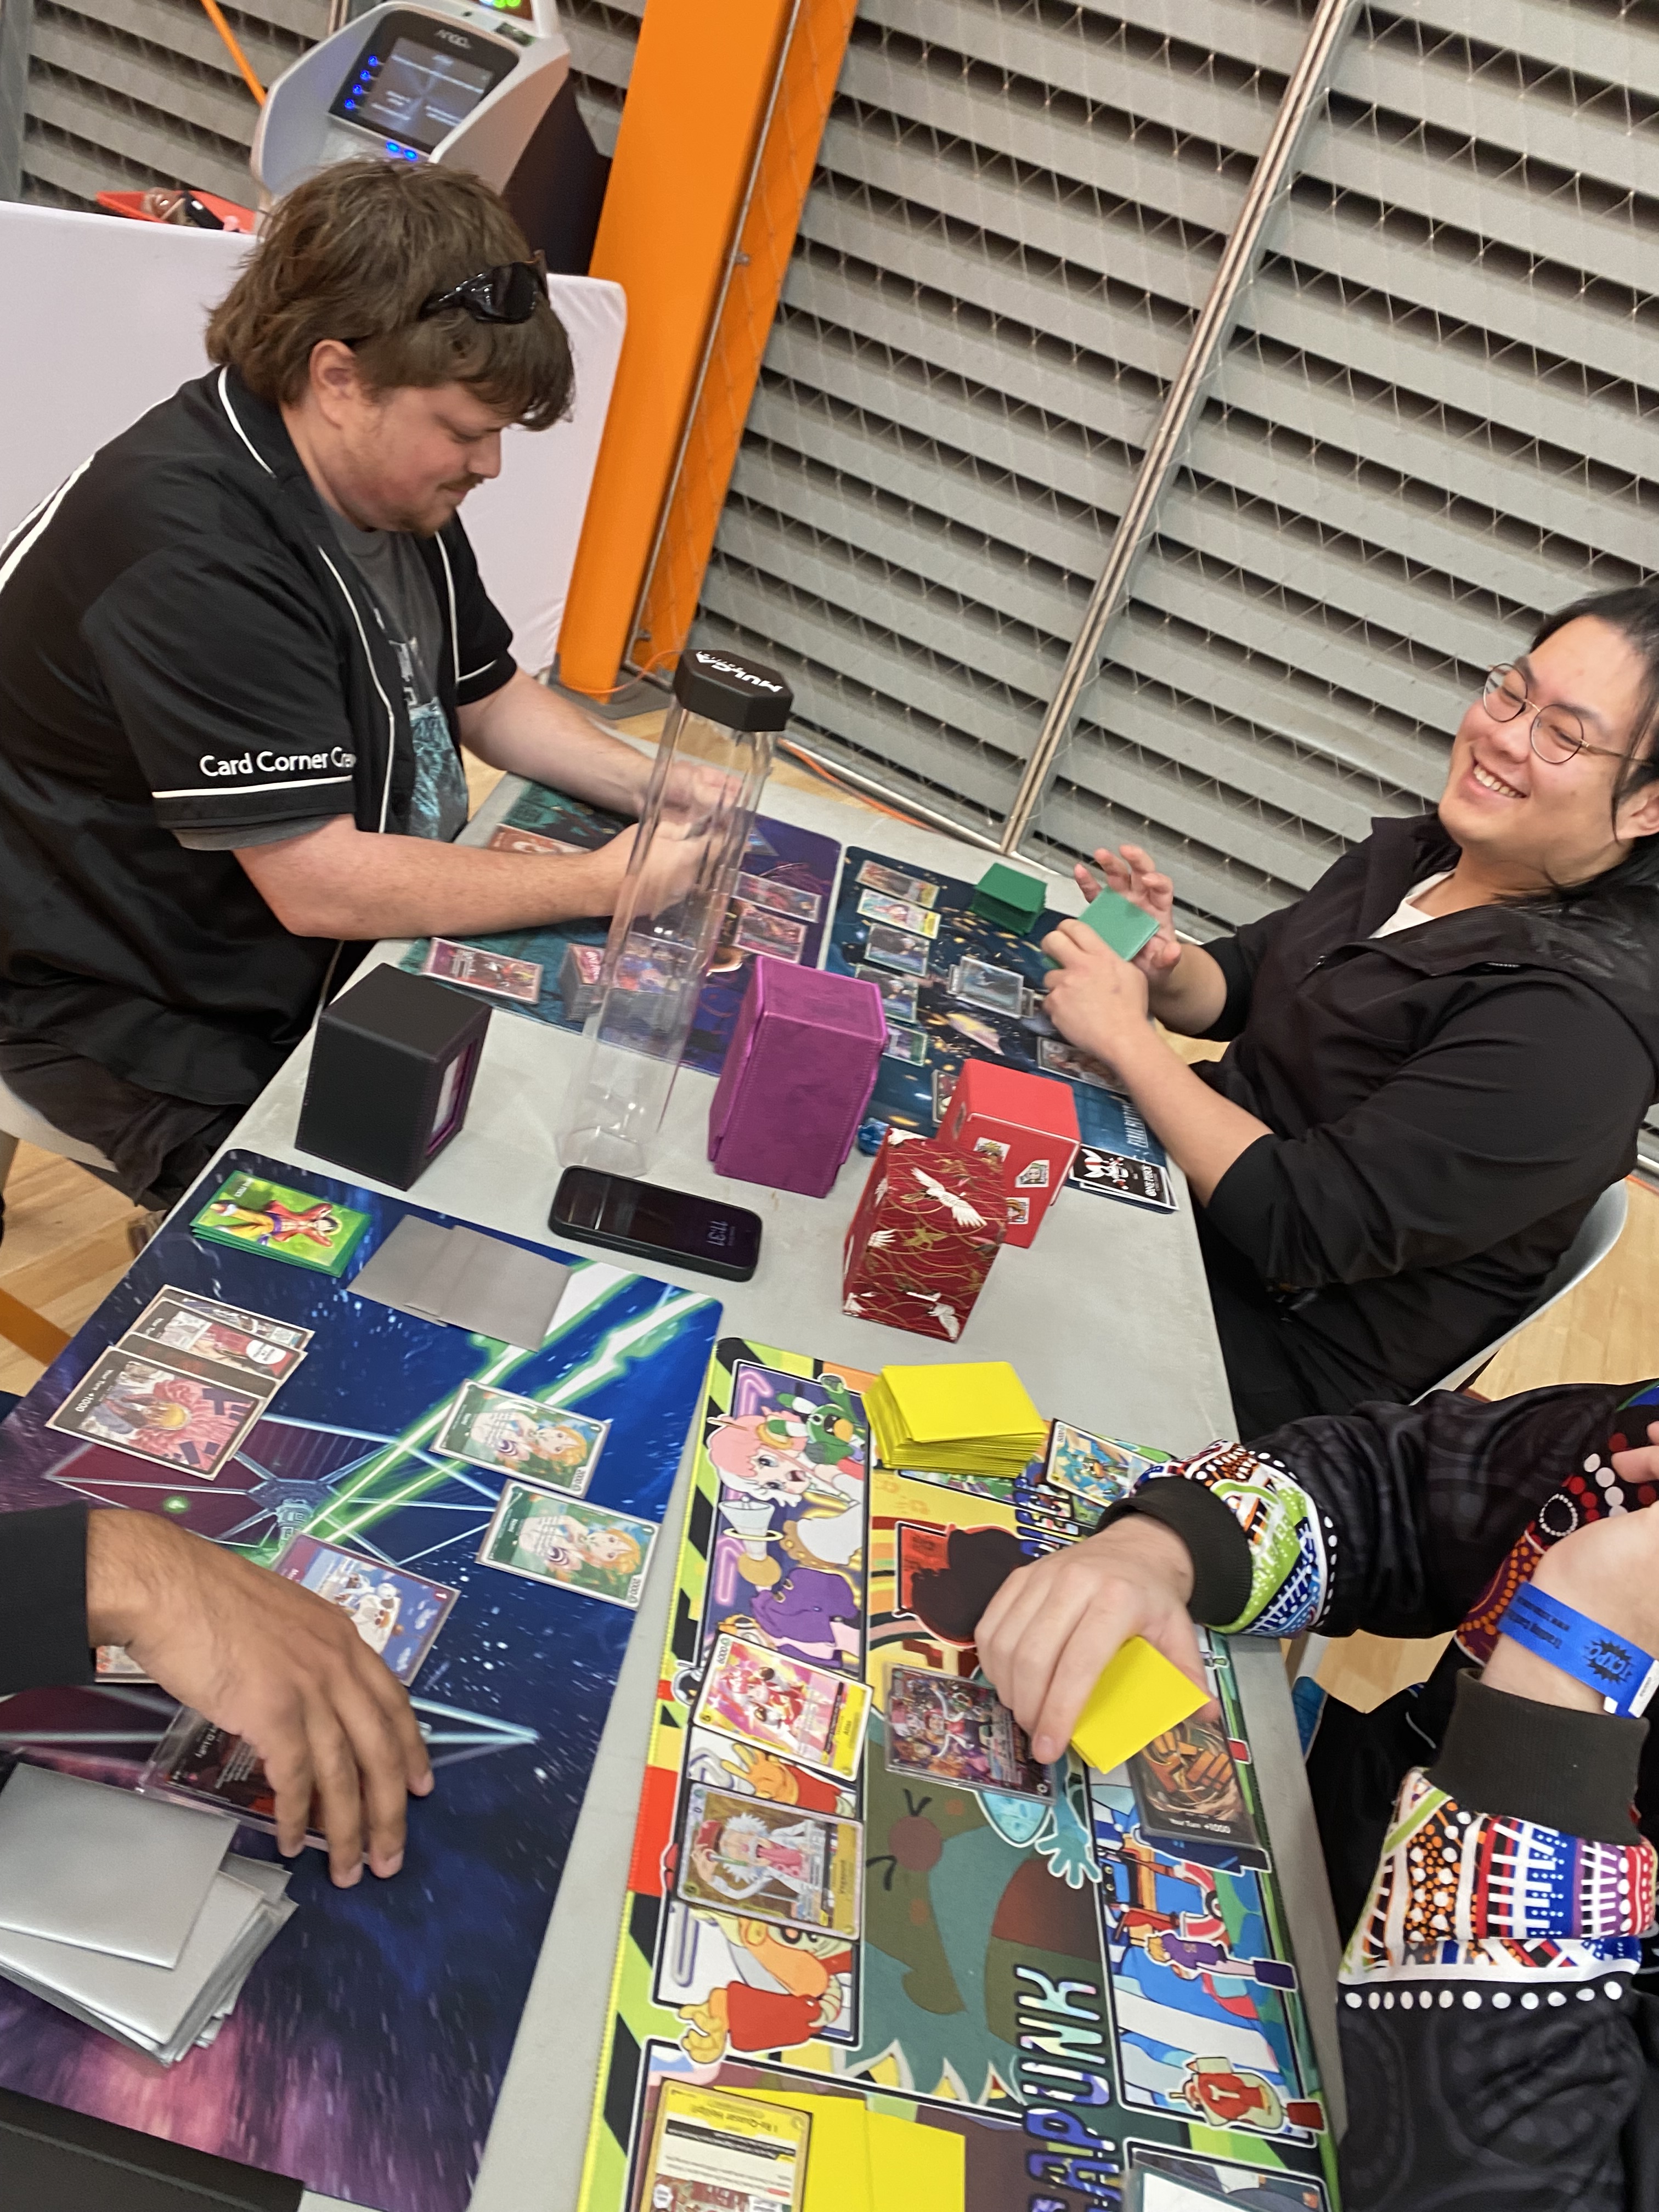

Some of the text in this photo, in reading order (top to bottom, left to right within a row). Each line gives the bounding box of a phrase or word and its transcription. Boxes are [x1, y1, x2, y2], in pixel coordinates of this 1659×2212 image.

[696, 652, 783, 692] MULGA
[199, 752, 253, 776] Card
[256, 751, 329, 772] Corner
[1141, 1164, 1154, 1182] PIECE
[1144, 1181, 1157, 1197] ONE
[75, 1393, 94, 1412] +1000
[716, 1646, 729, 1664] 6000
[1015, 1965, 1121, 2212] APUNK
